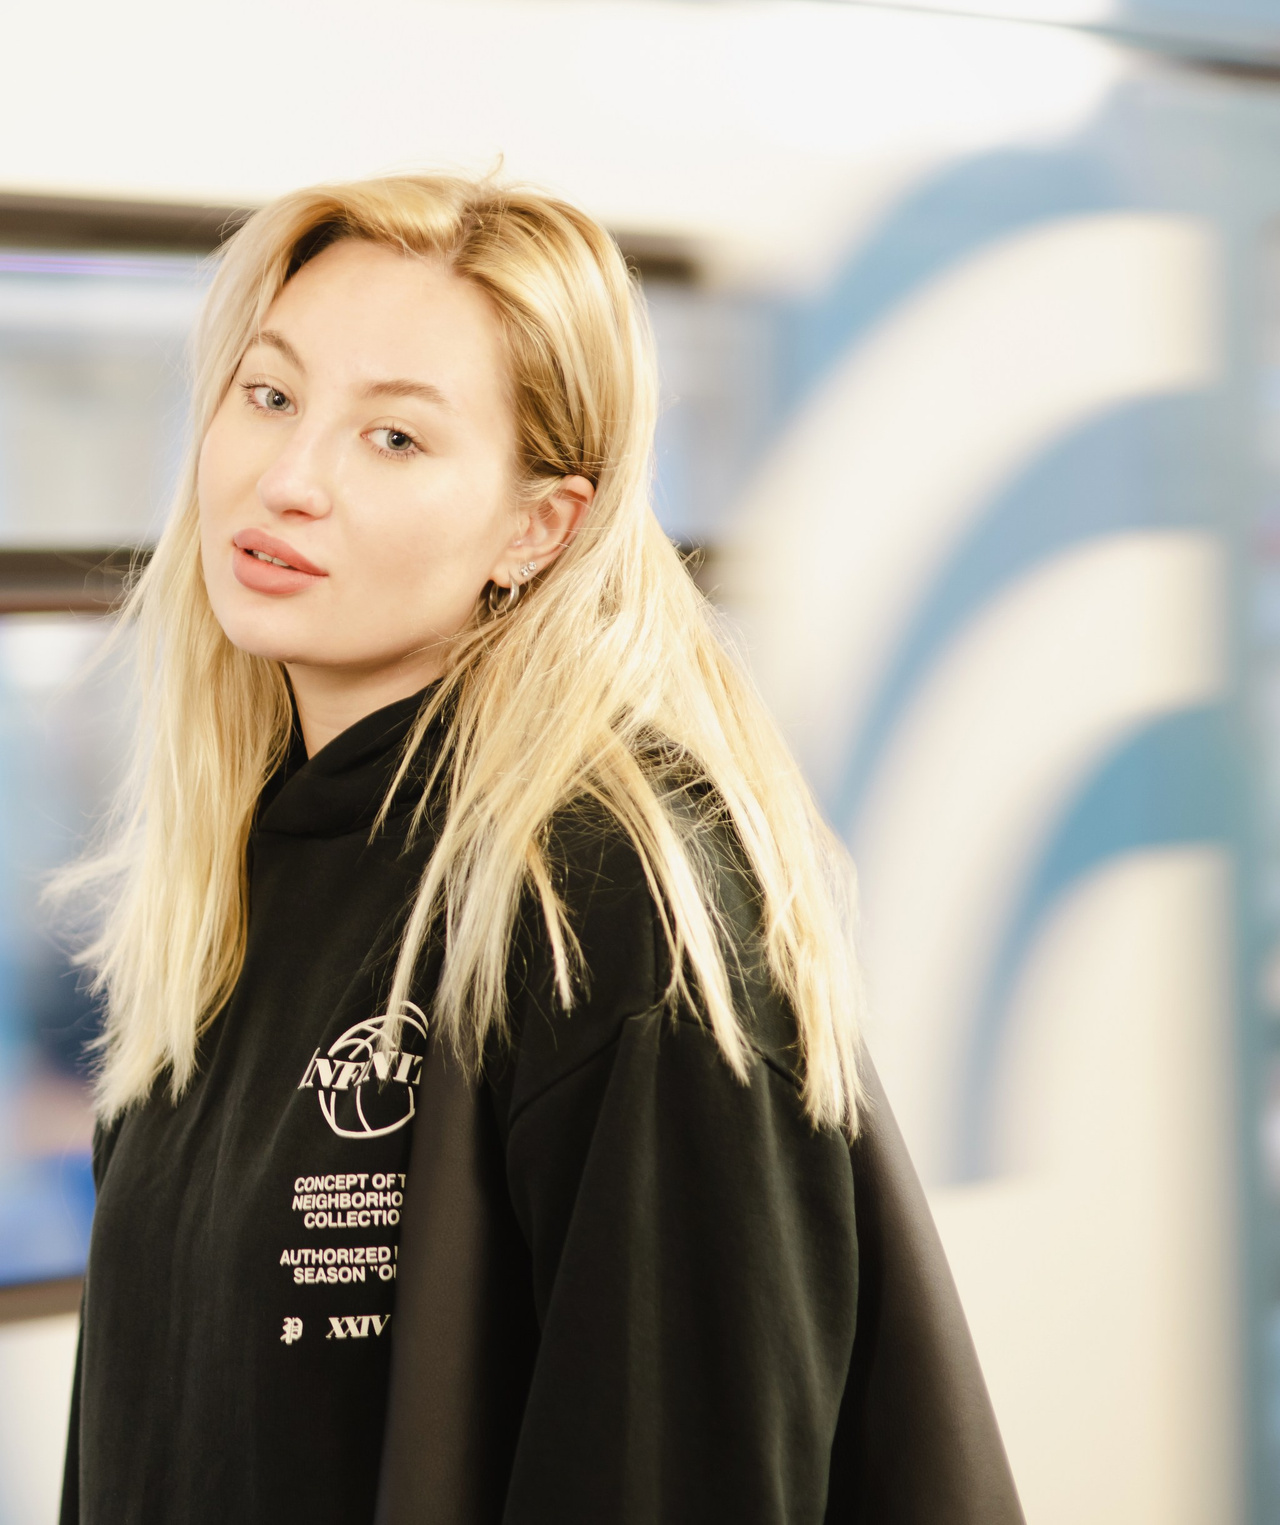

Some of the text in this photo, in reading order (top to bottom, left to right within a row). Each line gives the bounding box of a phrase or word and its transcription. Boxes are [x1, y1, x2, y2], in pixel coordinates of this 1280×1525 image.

[294, 1174, 369, 1193] CONCEPT
[372, 1173, 396, 1190] OF
[292, 1191, 403, 1211] NEIGHBORHO
[304, 1209, 402, 1229] COLLECTIO
[279, 1246, 391, 1266] AUTHORIZED
[293, 1266, 366, 1285] SEASON
[325, 1314, 391, 1340] XXIV
